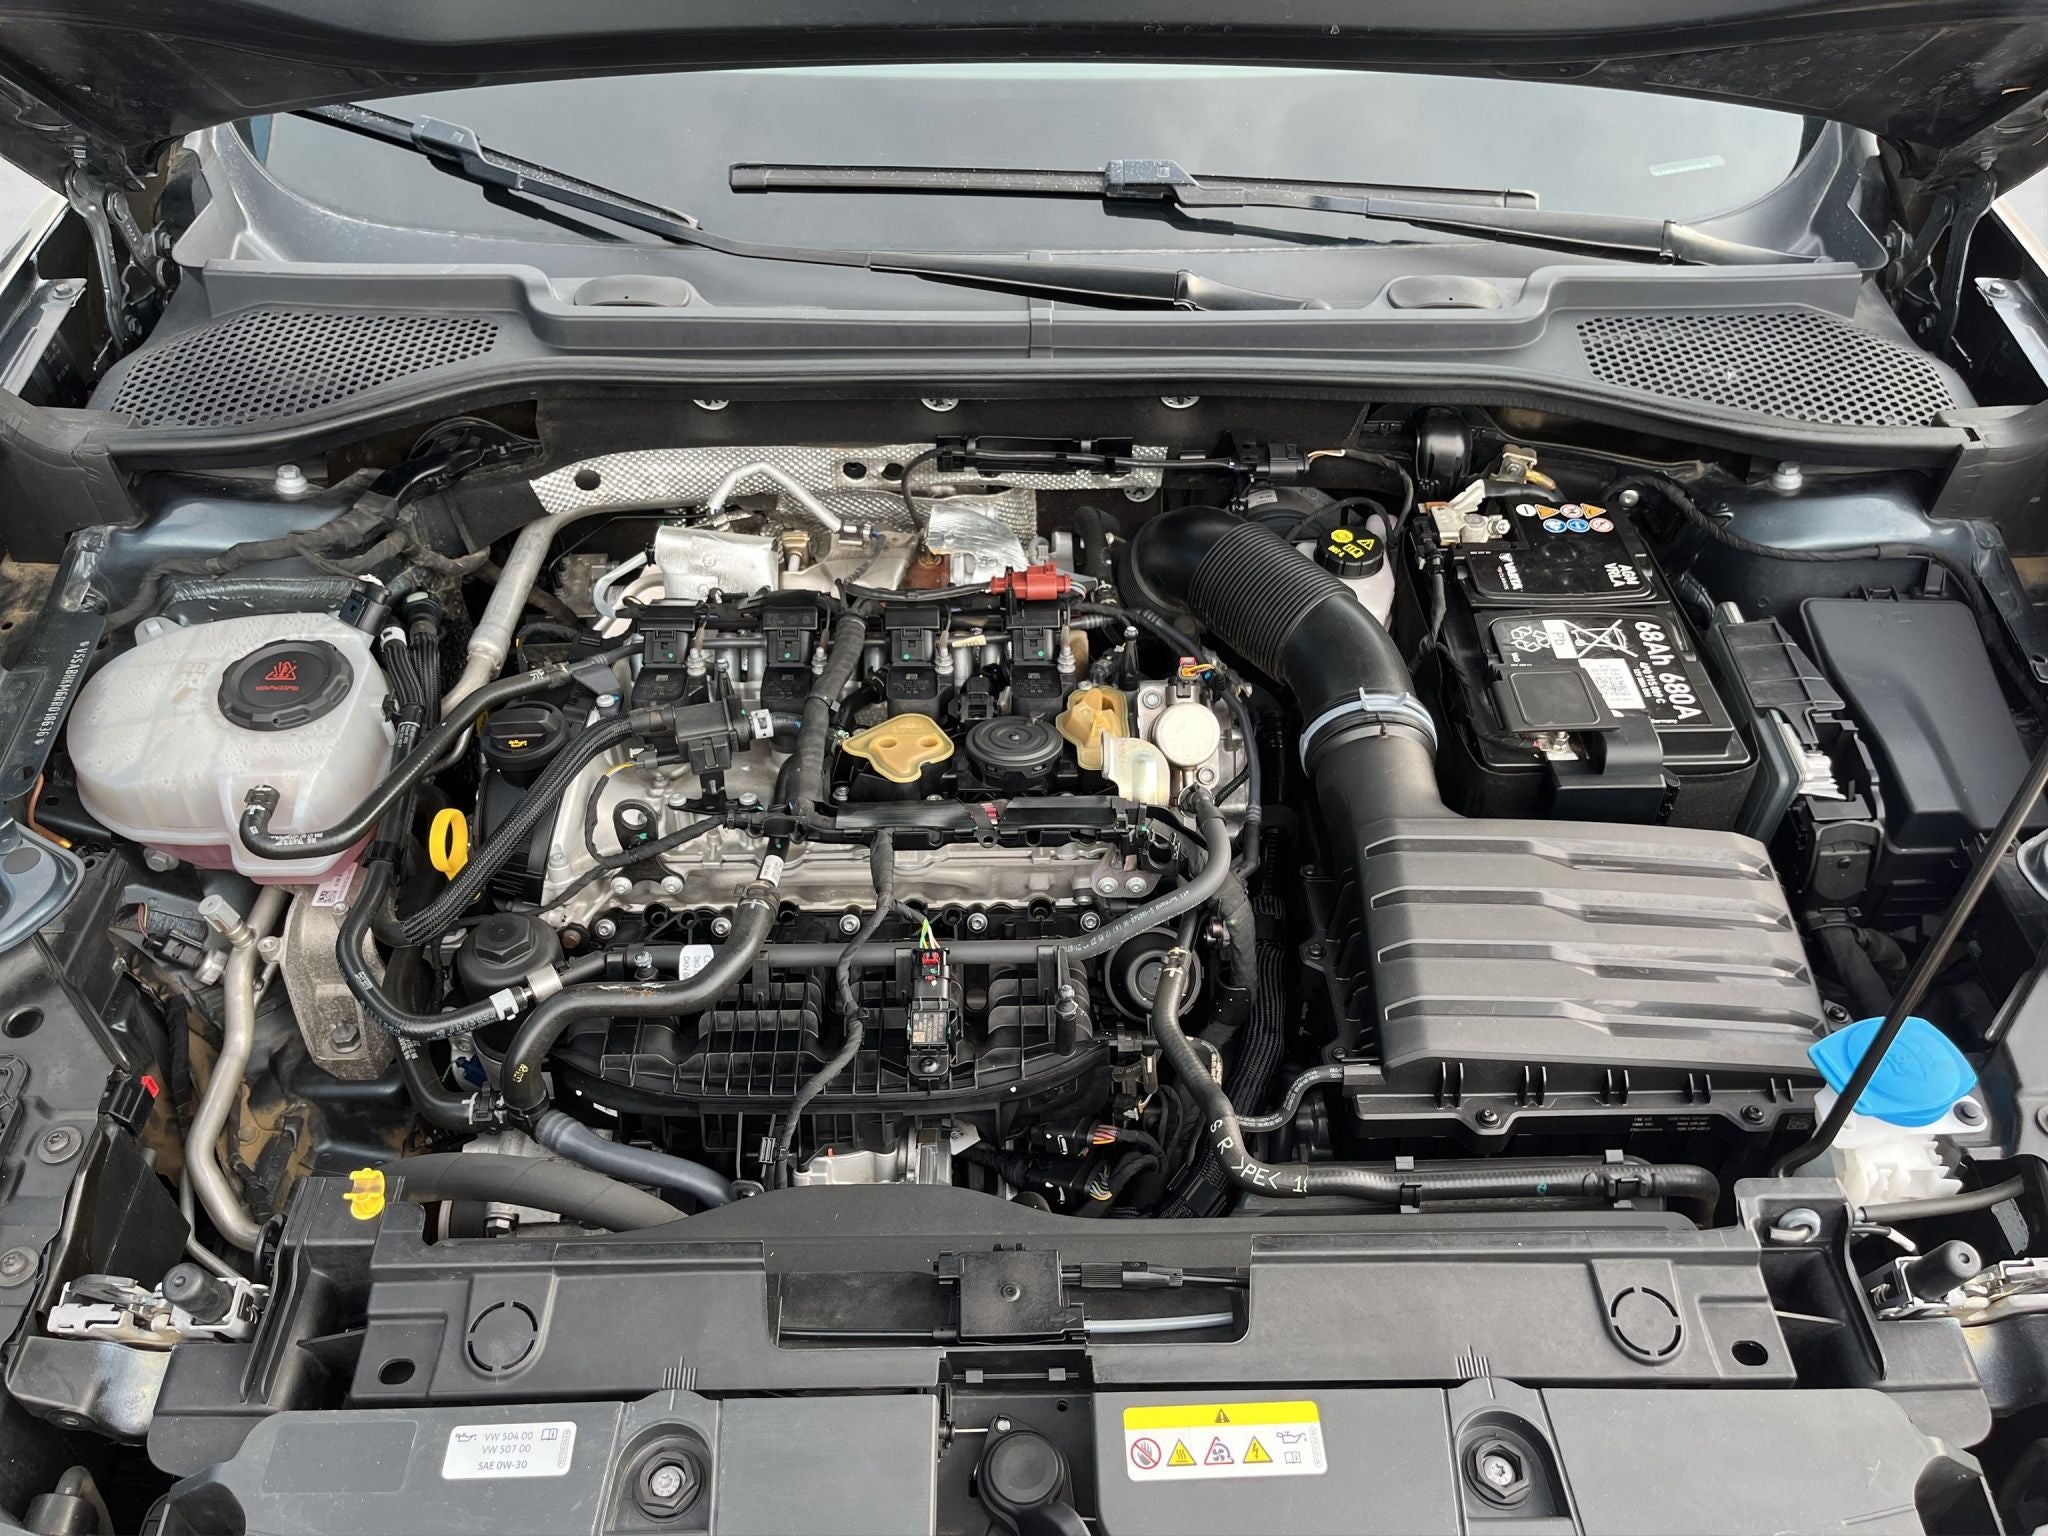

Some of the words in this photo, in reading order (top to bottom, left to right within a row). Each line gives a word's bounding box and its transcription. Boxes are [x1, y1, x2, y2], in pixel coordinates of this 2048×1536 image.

[1503, 562, 1523, 590] VARTA
[1604, 562, 1626, 588] VRLA
[1618, 563, 1641, 586] AGM
[1551, 631, 1566, 646] Pb
[1634, 620, 1671, 666] 68Ah
[1658, 671, 1702, 720] 680A
[1210, 1119, 1223, 1133] S
[1216, 1136, 1234, 1155] R
[484, 1432, 501, 1441] VW
[501, 1431, 519, 1441] 504
[521, 1431, 534, 1440] 00
[482, 1445, 498, 1454] VW
[499, 1444, 517, 1454] 507
[519, 1443, 532, 1453] 00
[477, 1461, 495, 1471] SAE
[496, 1460, 529, 1470] 0W-30
